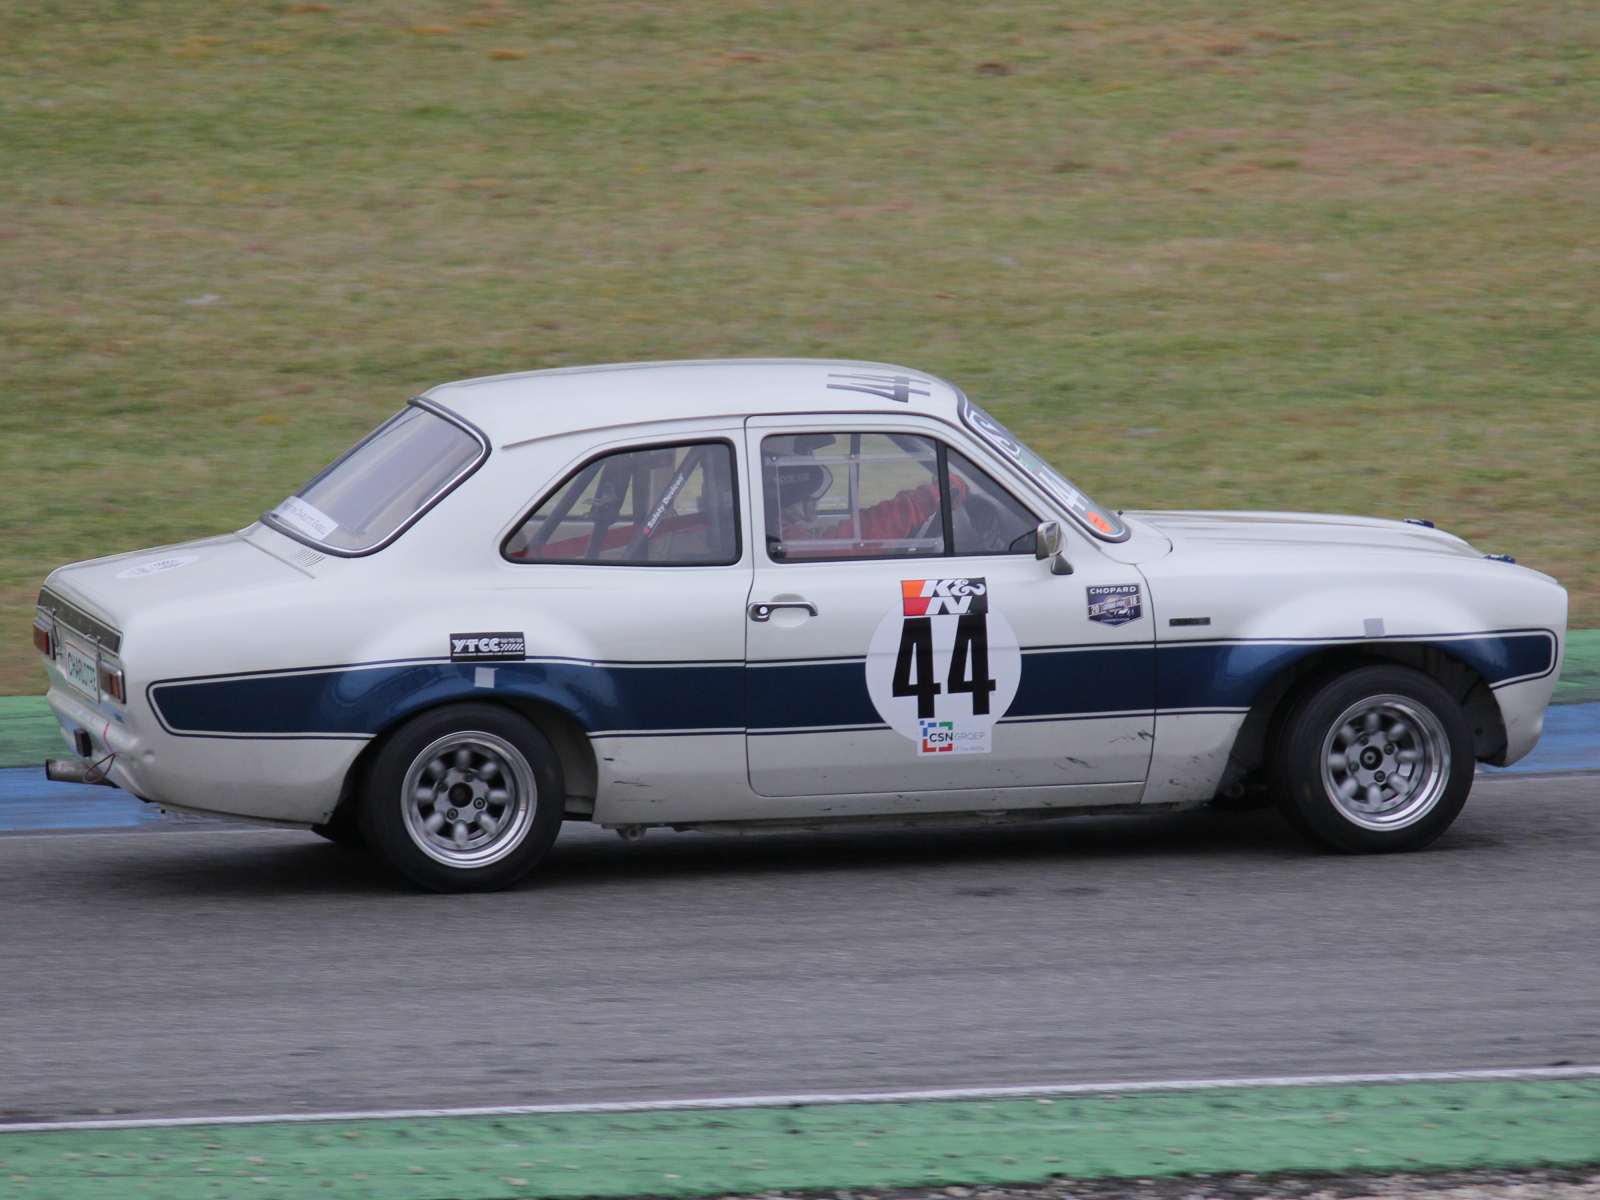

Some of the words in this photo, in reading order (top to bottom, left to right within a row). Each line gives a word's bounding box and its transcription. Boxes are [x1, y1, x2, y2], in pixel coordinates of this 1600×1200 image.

[826, 373, 931, 403] 44
[647, 504, 666, 529] Safety
[663, 473, 684, 505] Devices
[1090, 585, 1137, 595] CHOPARD
[452, 638, 500, 652] YTCC
[892, 614, 997, 719] 44
[929, 732, 954, 743] CSN
[954, 731, 986, 741] GROEP
